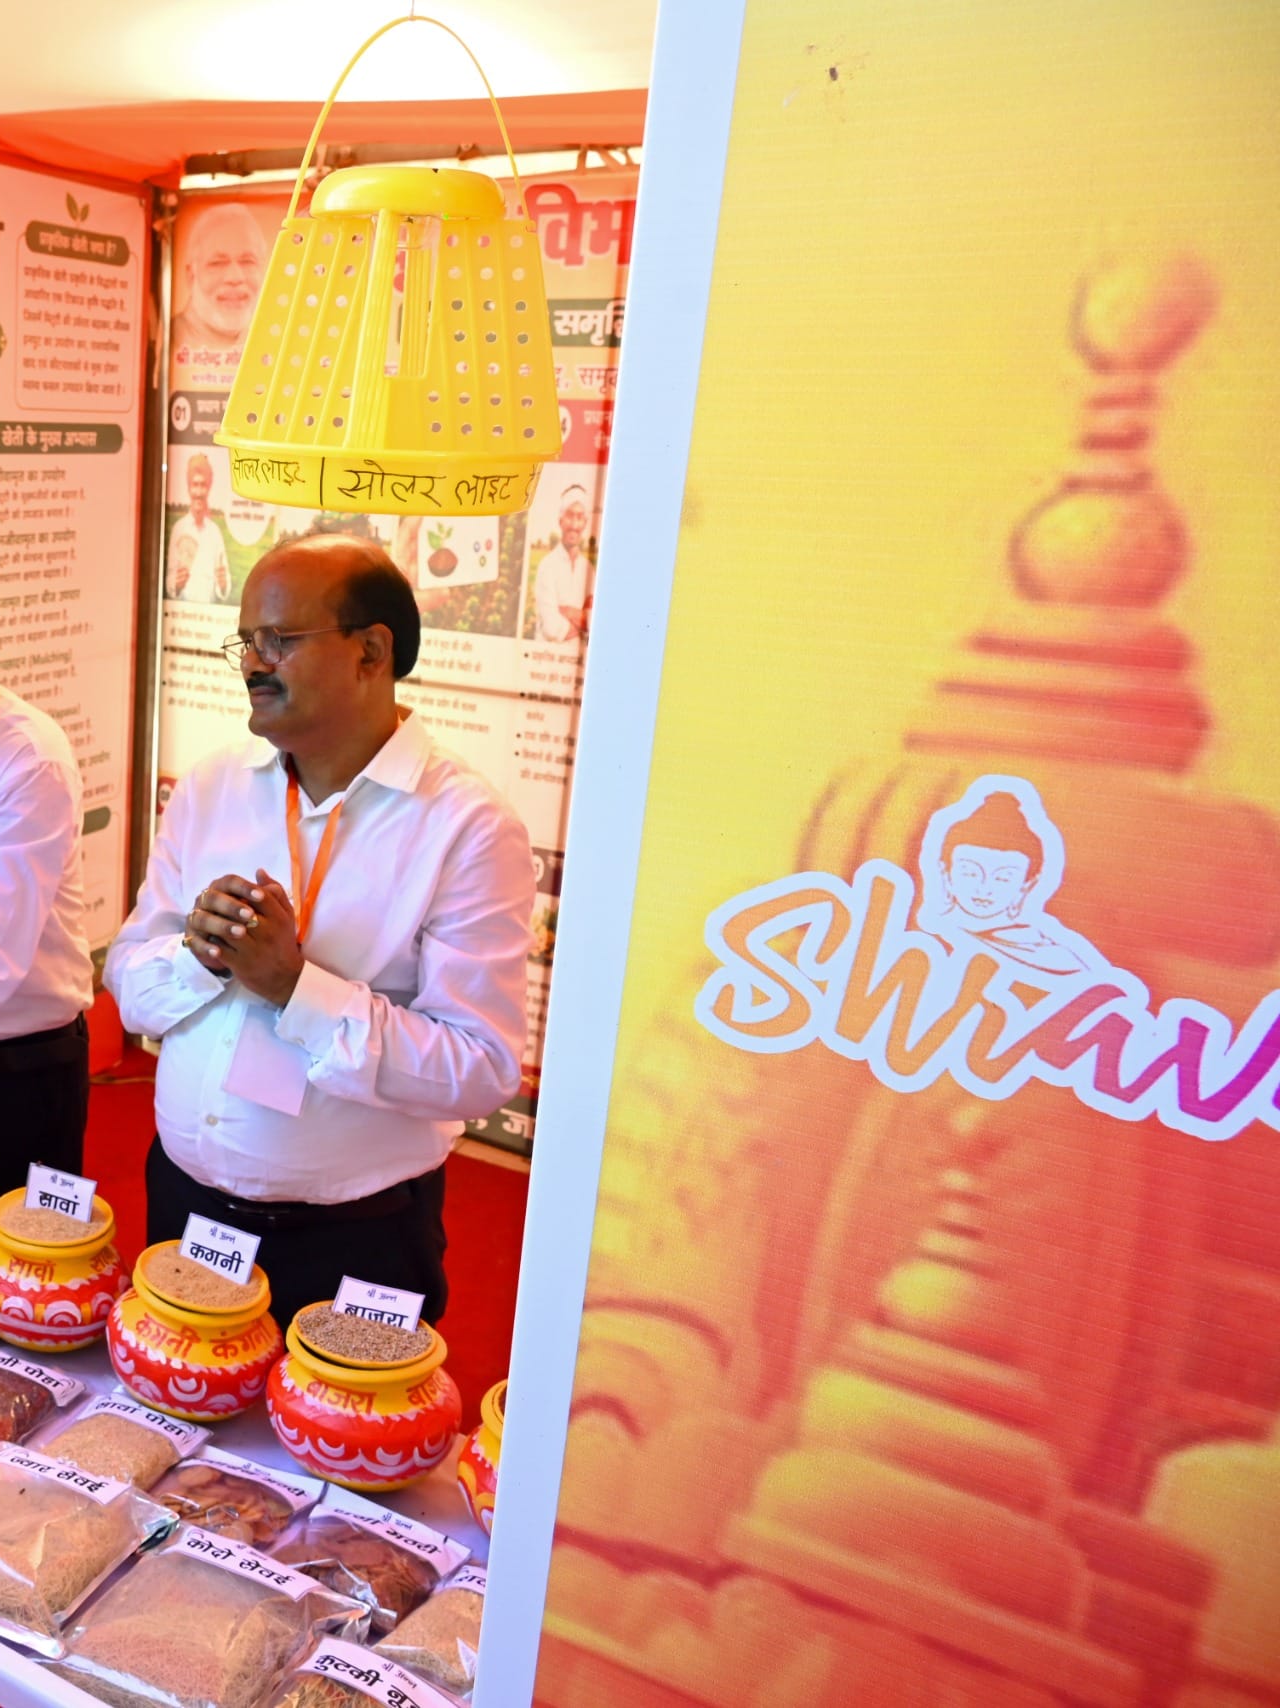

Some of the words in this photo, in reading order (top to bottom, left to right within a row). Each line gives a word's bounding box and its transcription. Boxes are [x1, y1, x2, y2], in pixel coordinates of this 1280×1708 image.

[1, 425, 24, 447] खेती
[27, 426, 38, 447] के
[338, 459, 447, 508] सोलर
[455, 474, 520, 507] लाइट
[700, 866, 1280, 1132] Shrav
[38, 1190, 81, 1216] सावां
[189, 1241, 245, 1274] कगनी
[344, 1302, 409, 1328] बाजरा
[24, 1365, 65, 1389] पोहा
[145, 1413, 188, 1436] पोहा
[187, 1536, 236, 1561] कोदो
[313, 1654, 385, 1688] कुटकी
